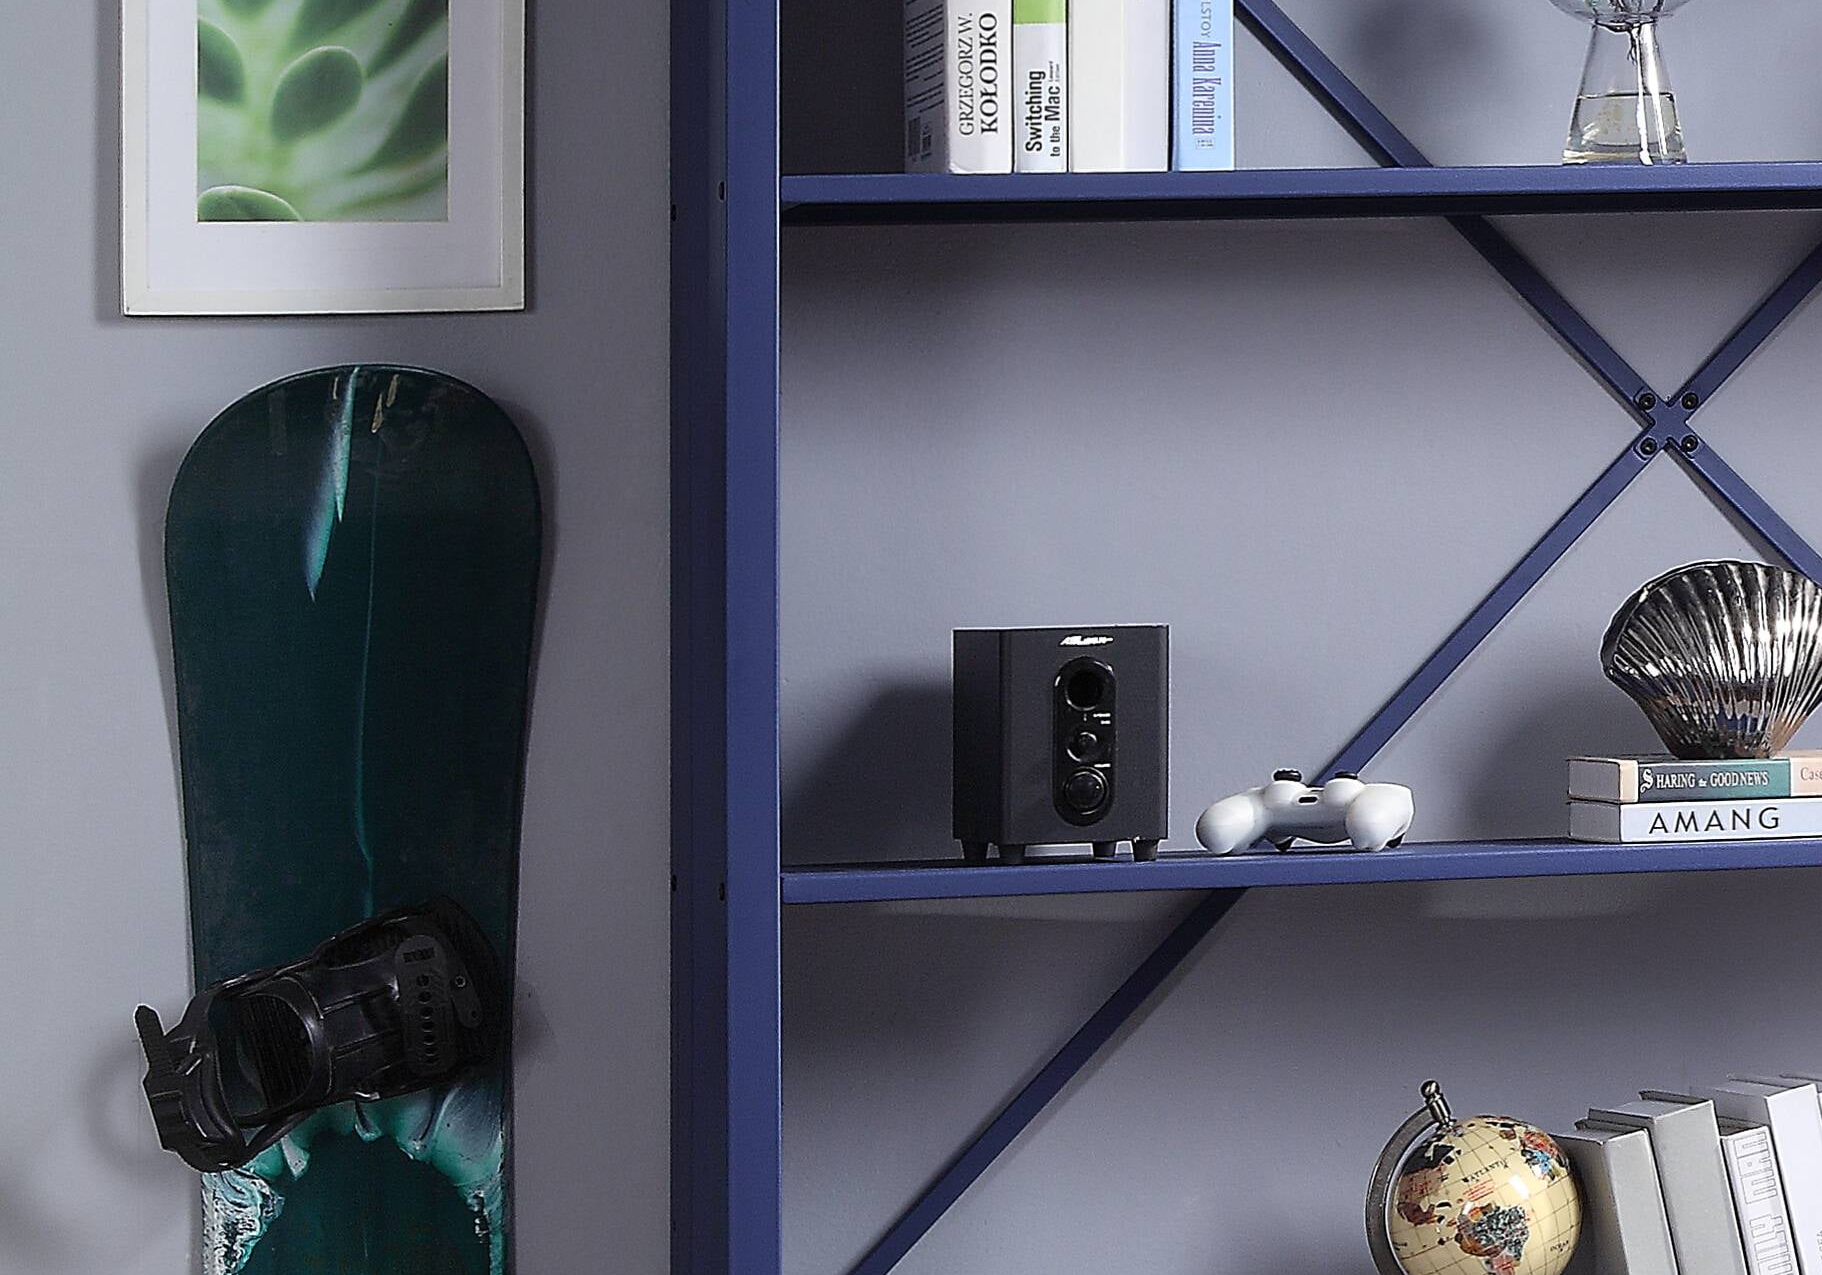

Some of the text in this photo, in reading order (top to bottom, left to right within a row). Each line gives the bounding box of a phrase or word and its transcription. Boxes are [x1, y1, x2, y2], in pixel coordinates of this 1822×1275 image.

[958, 12, 975, 136] GRZEGORZ W.
[978, 12, 999, 135] KOŁODKO
[1192, 41, 1222, 72] Anna
[1025, 70, 1047, 153] Switching
[1045, 85, 1061, 157] to the Mac
[1192, 78, 1222, 135] Karenina
[1640, 767, 1696, 794] SHARING
[1710, 771, 1739, 787] GOOD
[1740, 771, 1769, 786] NEWS
[1648, 806, 1780, 835] AMANG
[1734, 1130, 1778, 1205] MAN
